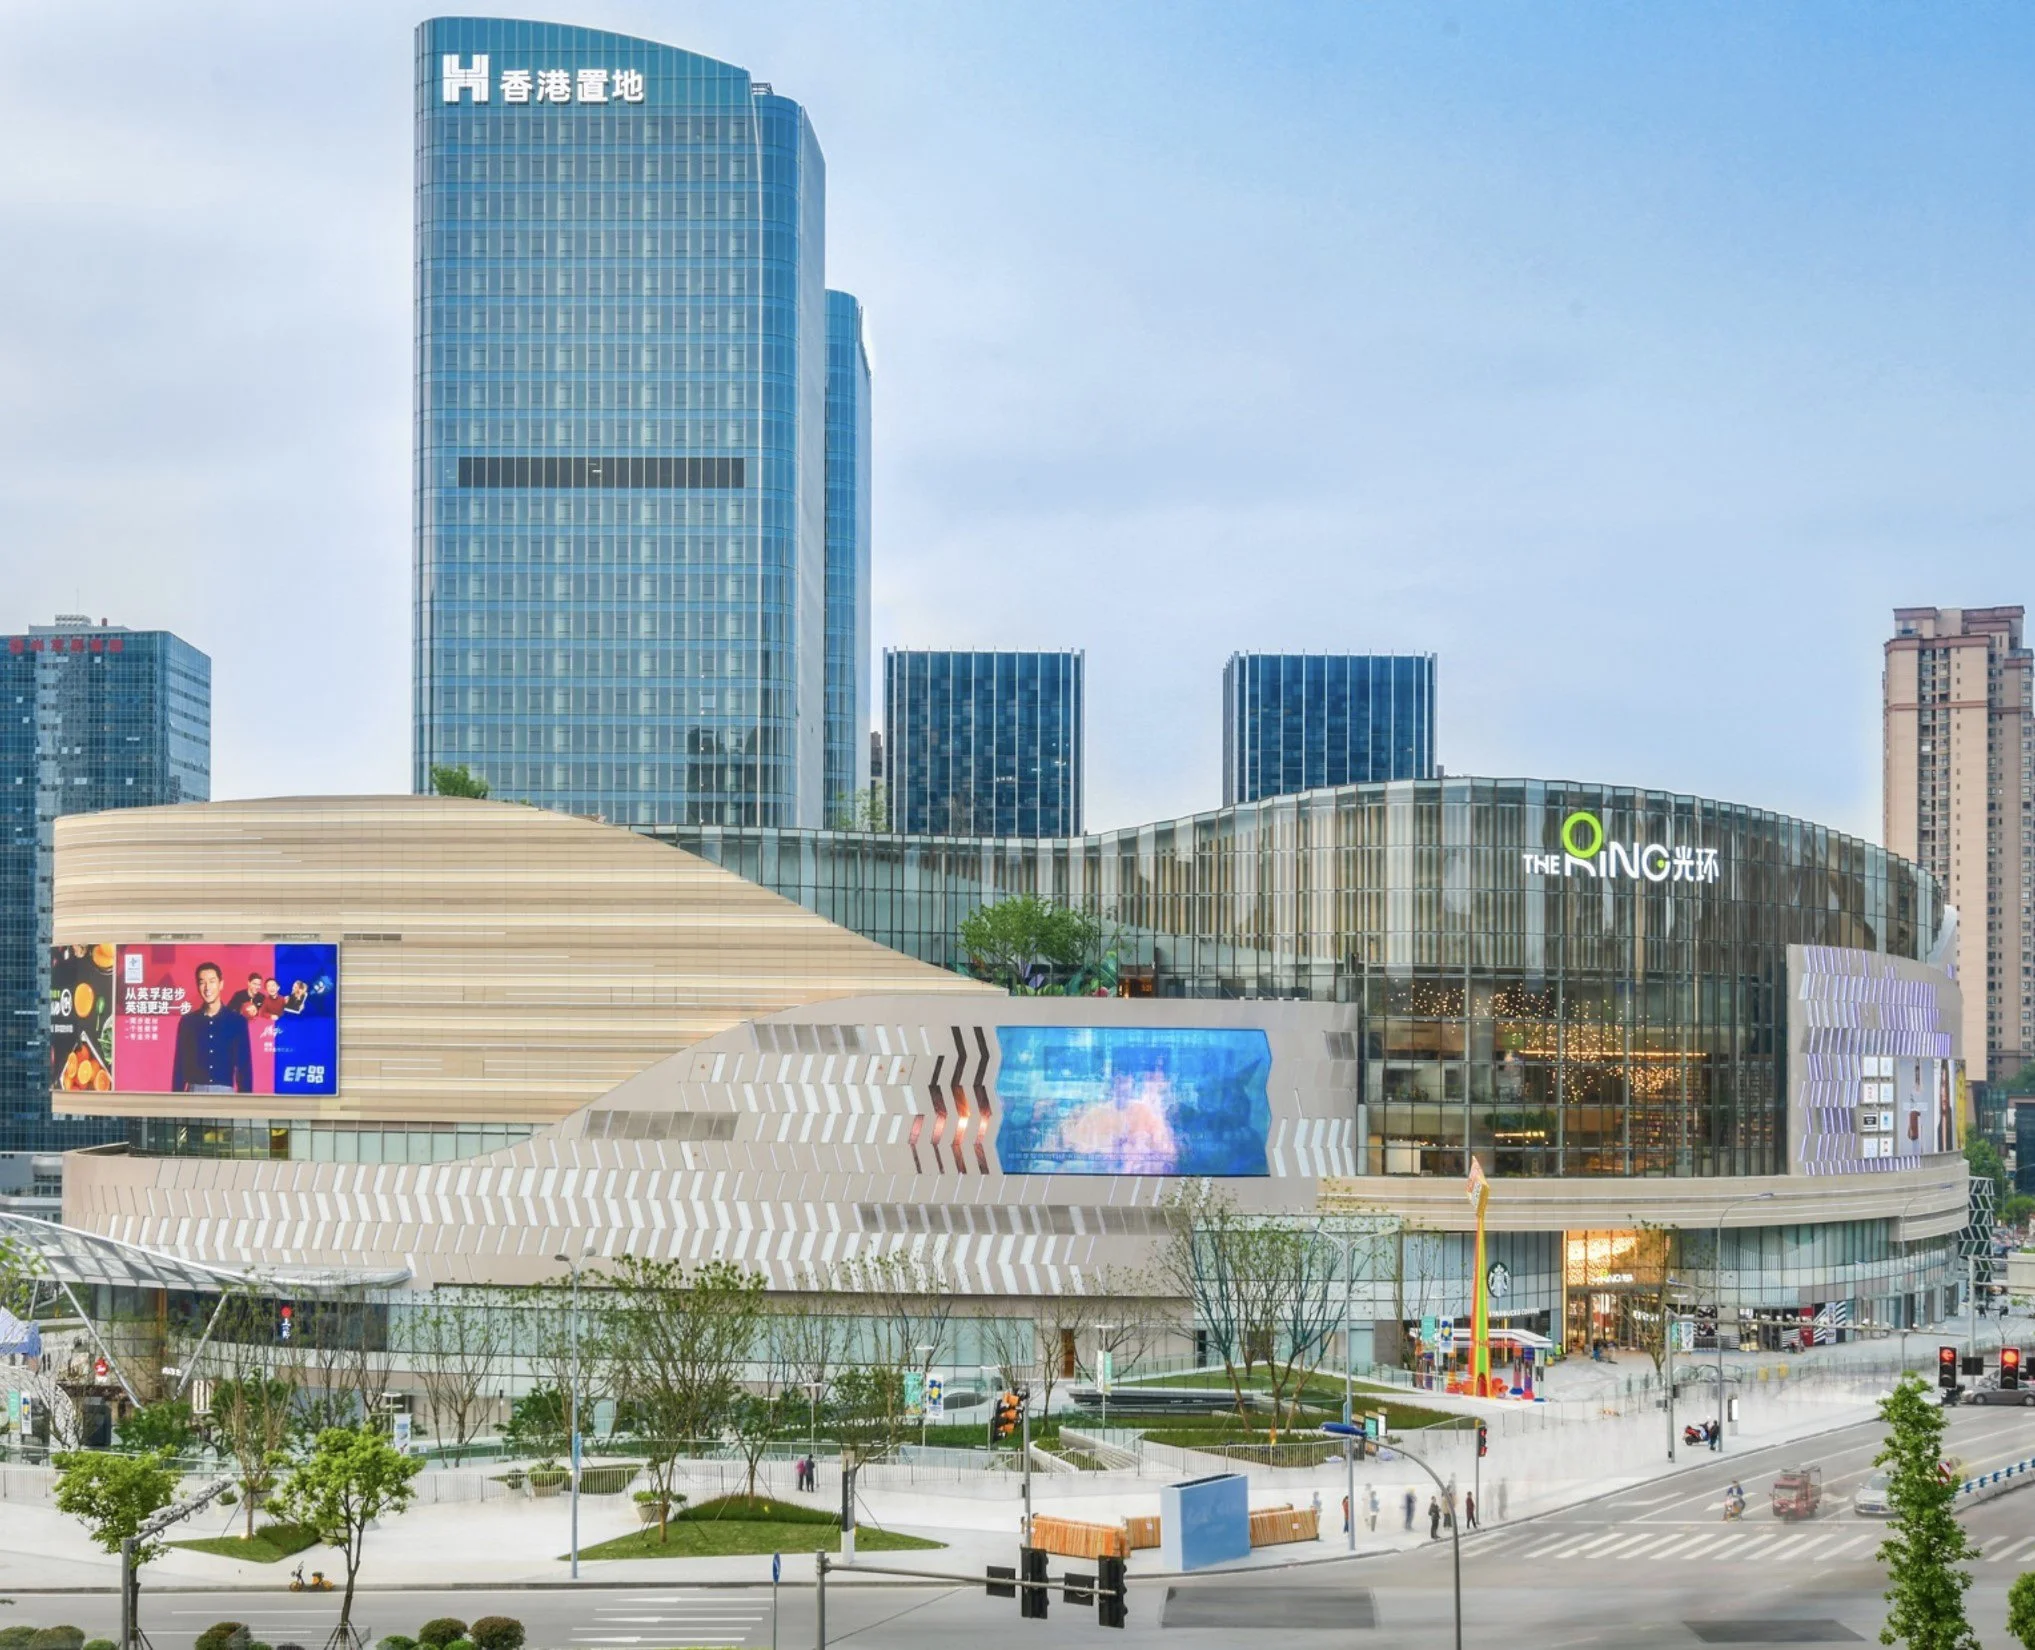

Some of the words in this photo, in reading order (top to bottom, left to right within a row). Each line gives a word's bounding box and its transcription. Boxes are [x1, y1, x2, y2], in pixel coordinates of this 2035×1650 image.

[501, 69, 645, 102] 香港置地
[1523, 855, 1560, 875] THE
[1562, 811, 1671, 882] RING
[1673, 845, 1720, 883] 光环
[125, 987, 186, 1001] 从英孚起步
[125, 1001, 192, 1016] 英语更进一步
